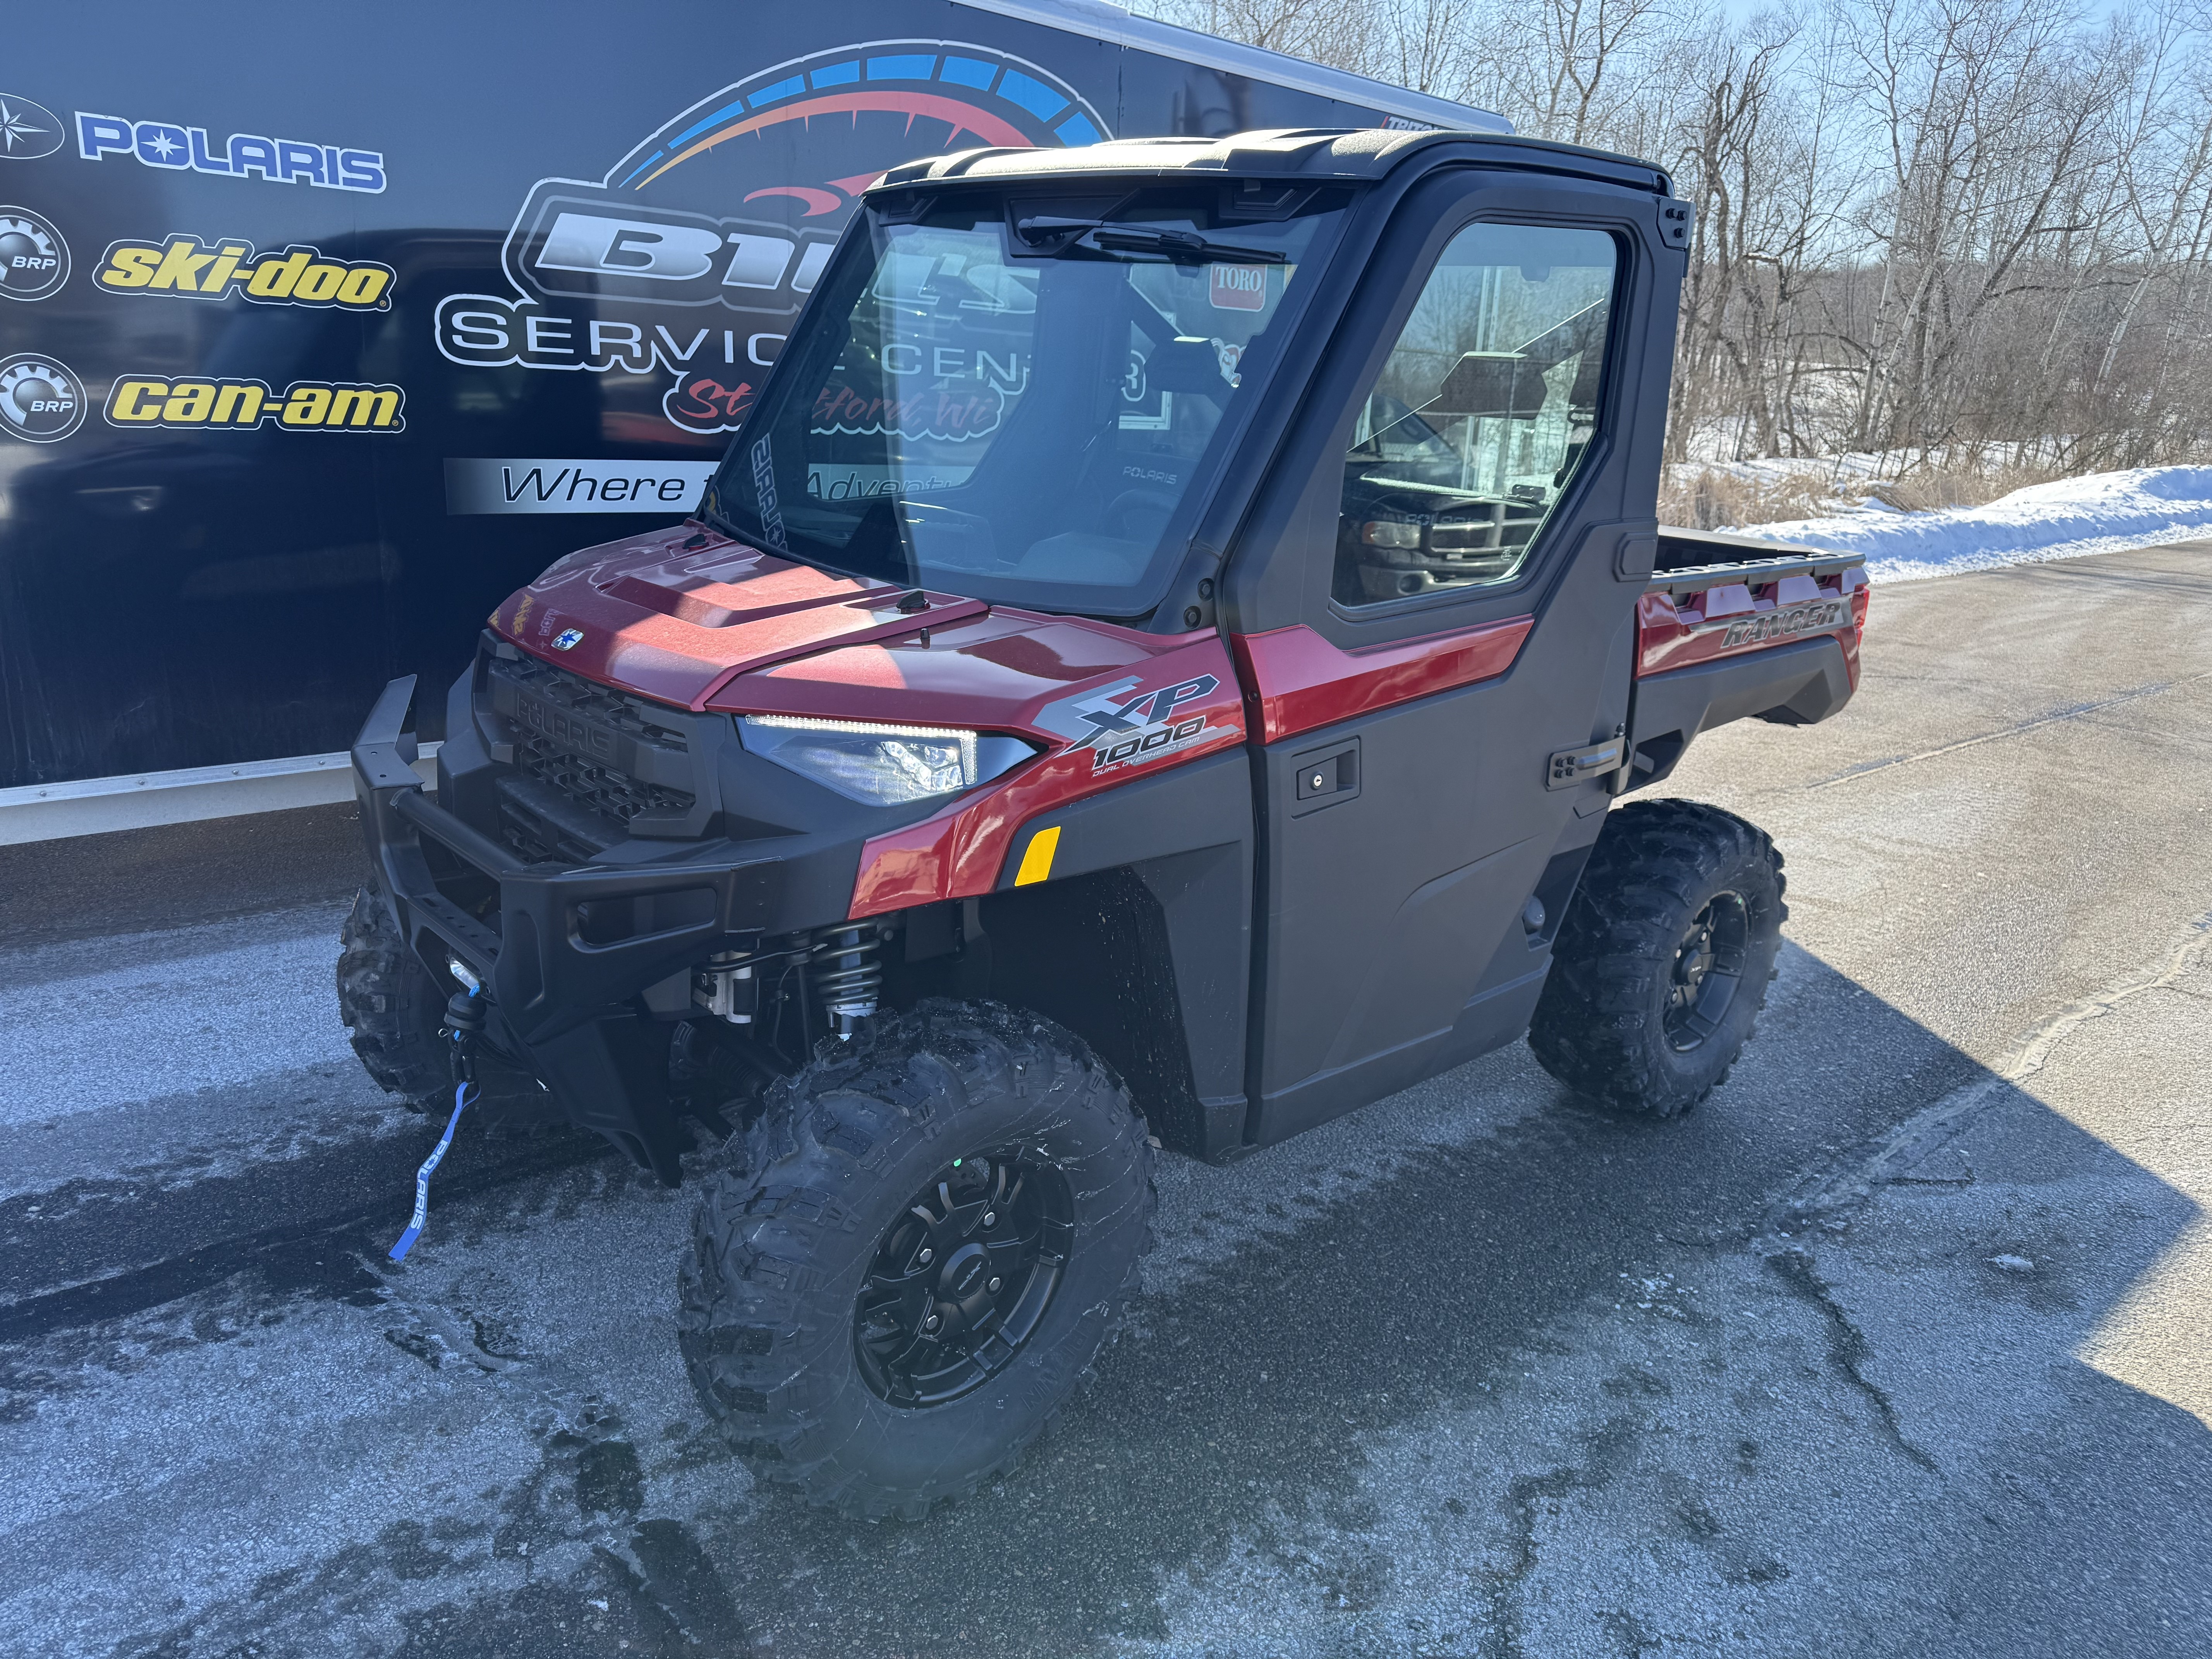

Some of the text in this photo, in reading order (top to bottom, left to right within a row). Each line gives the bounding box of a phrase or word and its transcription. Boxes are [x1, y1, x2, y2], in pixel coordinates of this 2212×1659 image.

[75, 112, 386, 193] POLARIS
[12, 256, 57, 270] BRP
[1215, 266, 1262, 292] TORO
[452, 311, 846, 371] SERVIC
[30, 400, 74, 413] BRP
[112, 381, 399, 426] can-am
[935, 392, 994, 429] Wi
[502, 467, 685, 503] Where
[1123, 466, 1177, 484] POLARIS
[1720, 601, 1843, 649] RANGER
[517, 693, 610, 760] POLARIS
[1054, 673, 1220, 758] XP
[1092, 715, 1207, 771] 1000
[1092, 737, 1200, 777] DUAL OVERHEAD CAM
[410, 1139, 448, 1230] POLARIS
